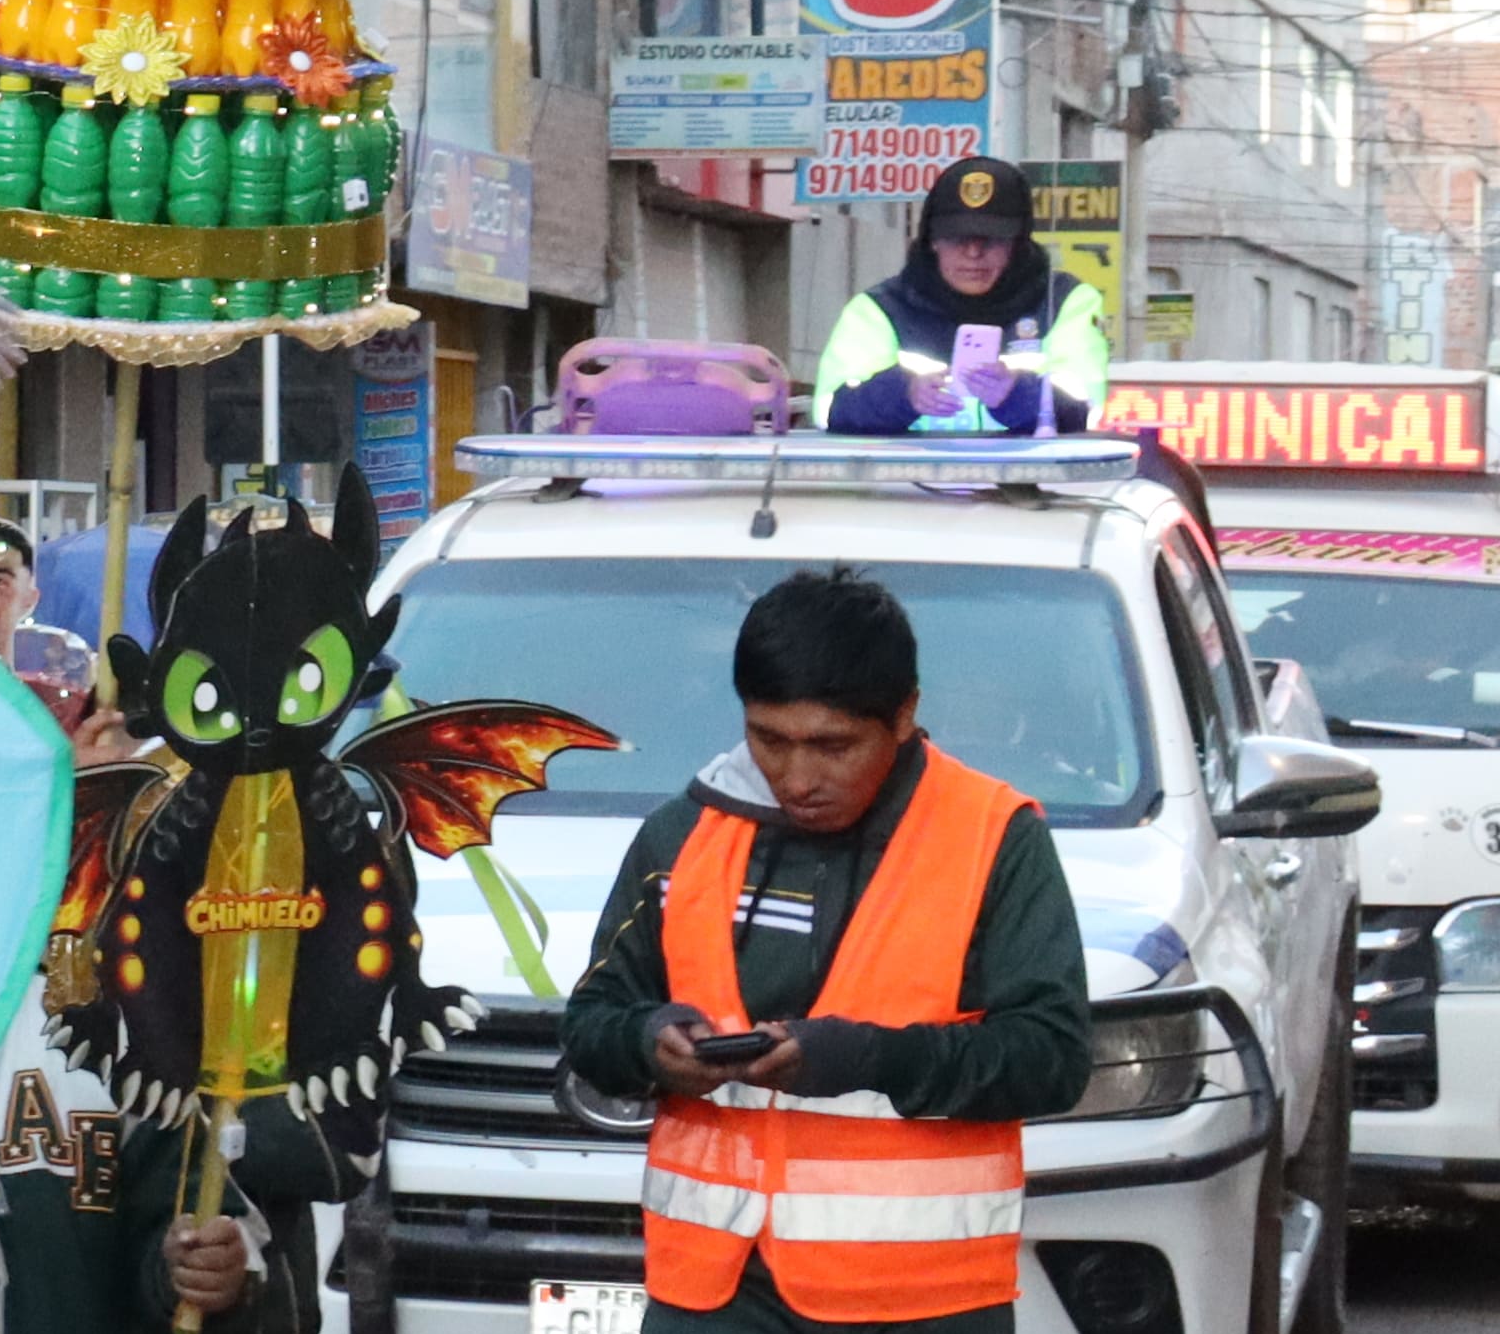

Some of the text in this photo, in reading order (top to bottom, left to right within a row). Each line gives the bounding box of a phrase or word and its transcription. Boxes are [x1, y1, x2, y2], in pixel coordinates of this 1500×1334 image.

[638, 43, 797, 62] ESTUDIO CONTABLE
[829, 33, 964, 56] DISTRIBUCIONES
[827, 49, 988, 103] AREDES
